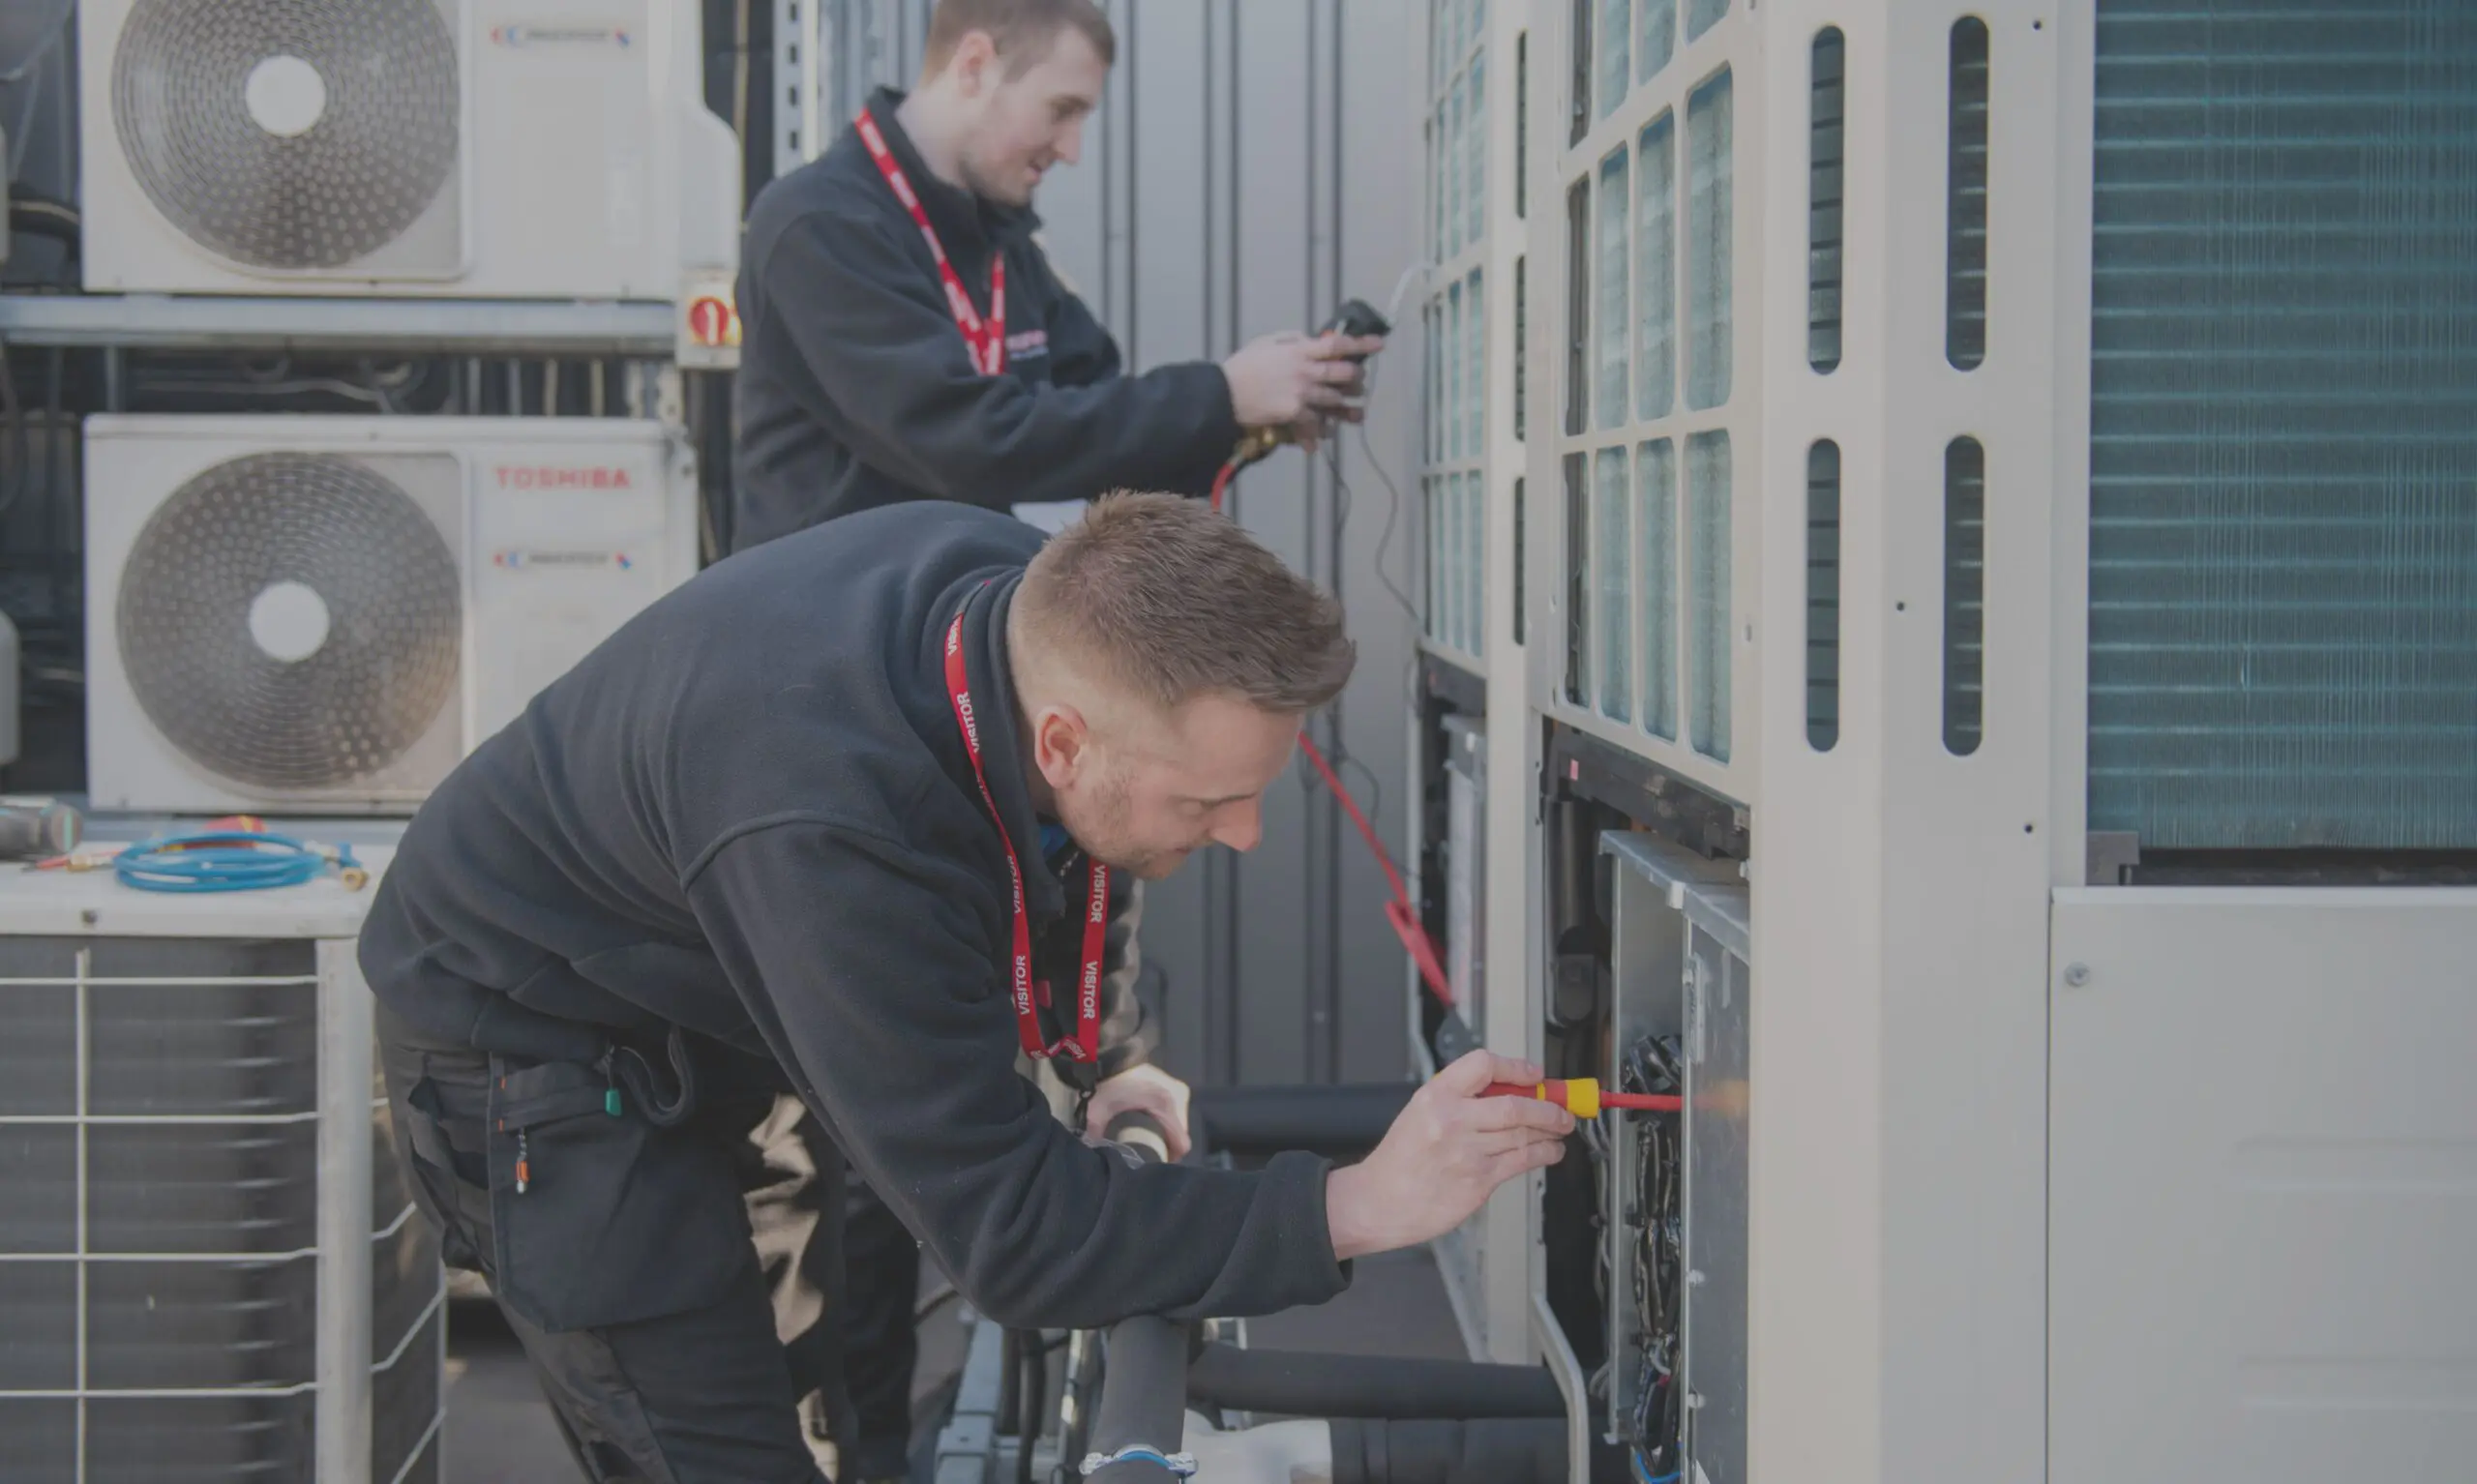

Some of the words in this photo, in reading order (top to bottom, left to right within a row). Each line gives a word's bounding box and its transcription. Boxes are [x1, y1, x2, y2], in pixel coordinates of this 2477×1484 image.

[495, 466, 632, 490] TOSHIBA
[956, 691, 980, 754] VISITOR
[1090, 864, 1106, 924] VISITOR
[1016, 955, 1030, 1015] VISITOR
[1084, 961, 1098, 1020] VISITOR
